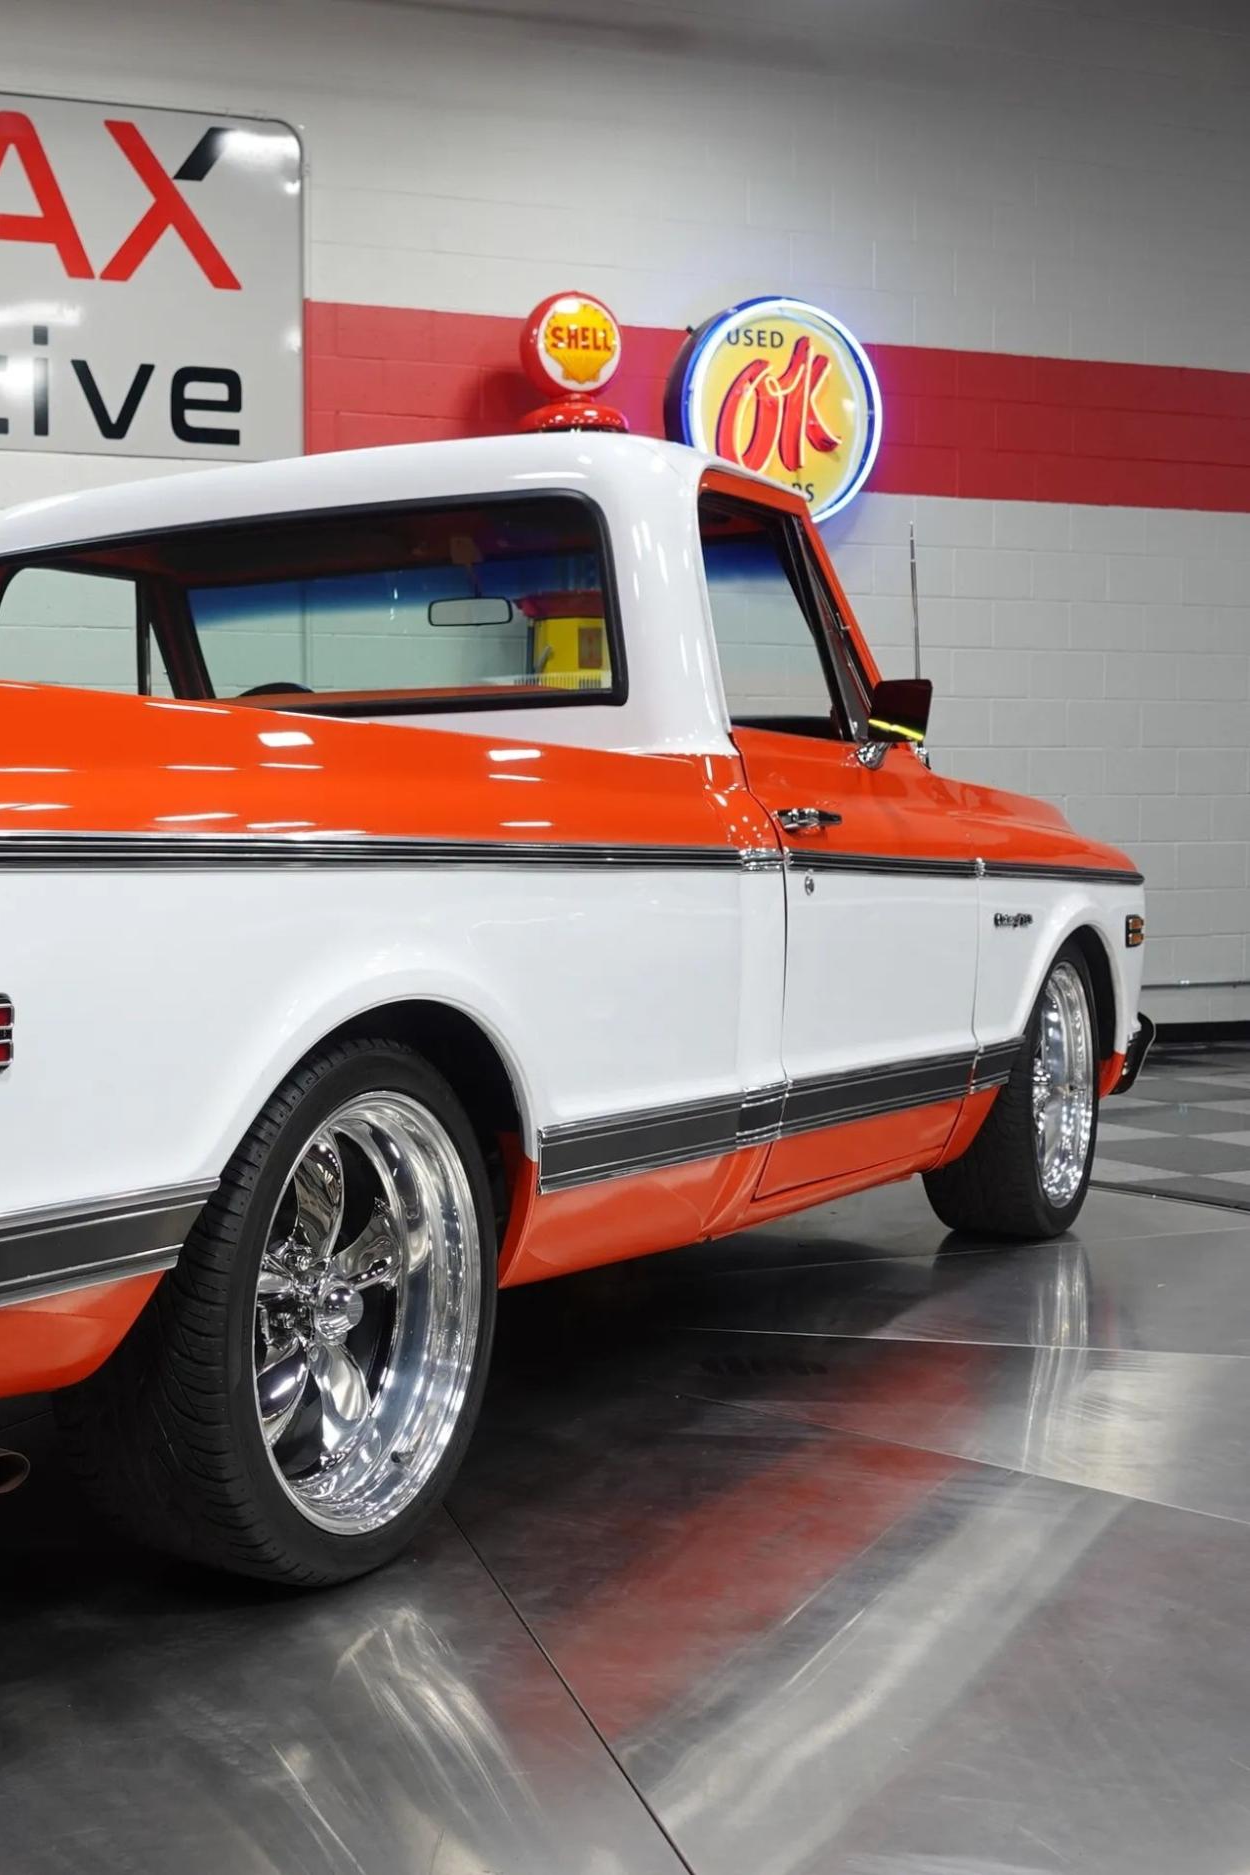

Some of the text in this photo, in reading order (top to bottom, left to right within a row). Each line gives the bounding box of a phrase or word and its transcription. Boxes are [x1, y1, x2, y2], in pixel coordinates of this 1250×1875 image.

[551, 326, 612, 351] SHELL
[726, 328, 784, 349] USED
[715, 336, 842, 472] OK
